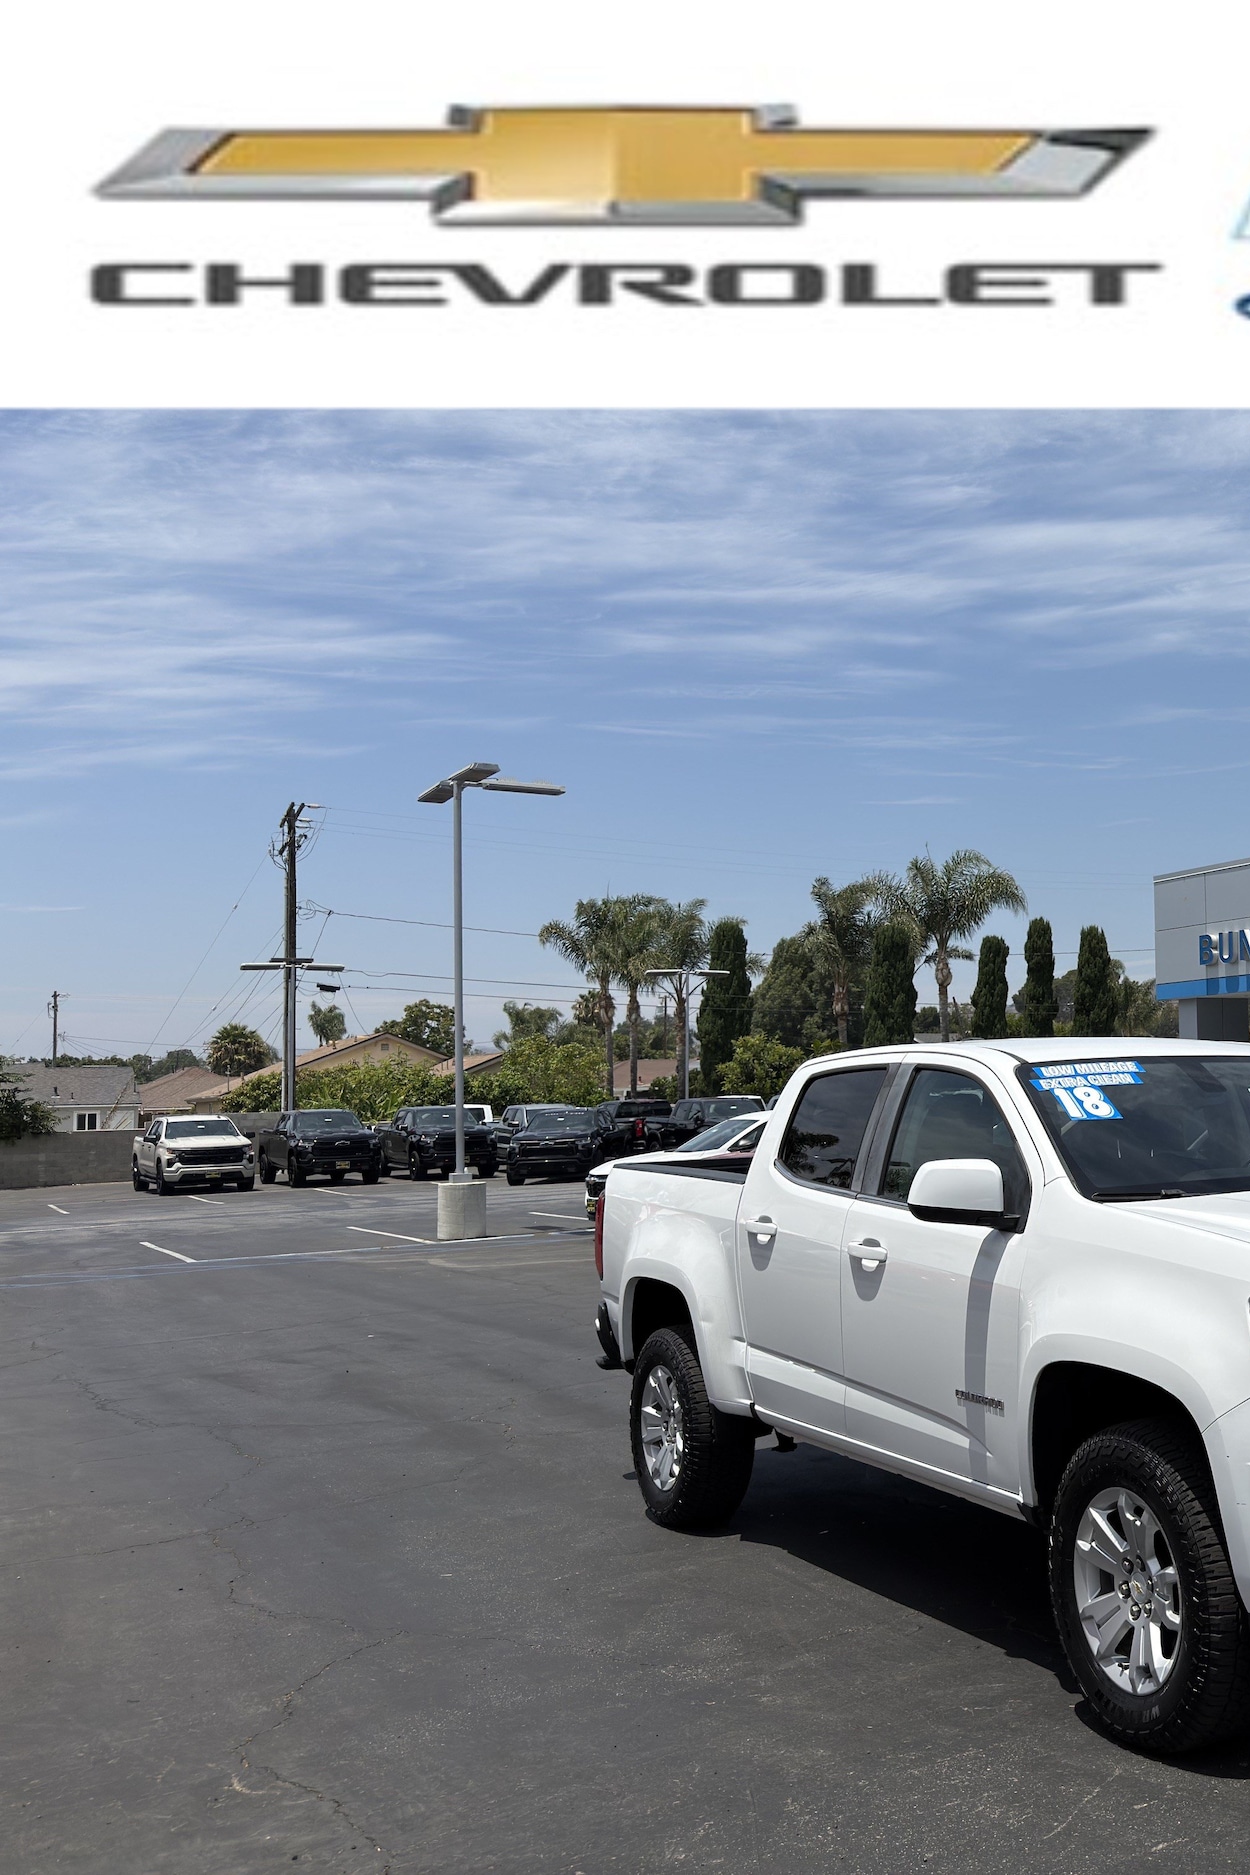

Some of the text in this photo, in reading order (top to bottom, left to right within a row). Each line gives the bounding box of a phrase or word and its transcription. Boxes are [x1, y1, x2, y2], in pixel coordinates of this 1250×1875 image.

[1041, 1061, 1139, 1077] LOW MILEAGE
[1039, 1072, 1135, 1090] EXTRA CLEAN
[1053, 1086, 1115, 1119] 18
